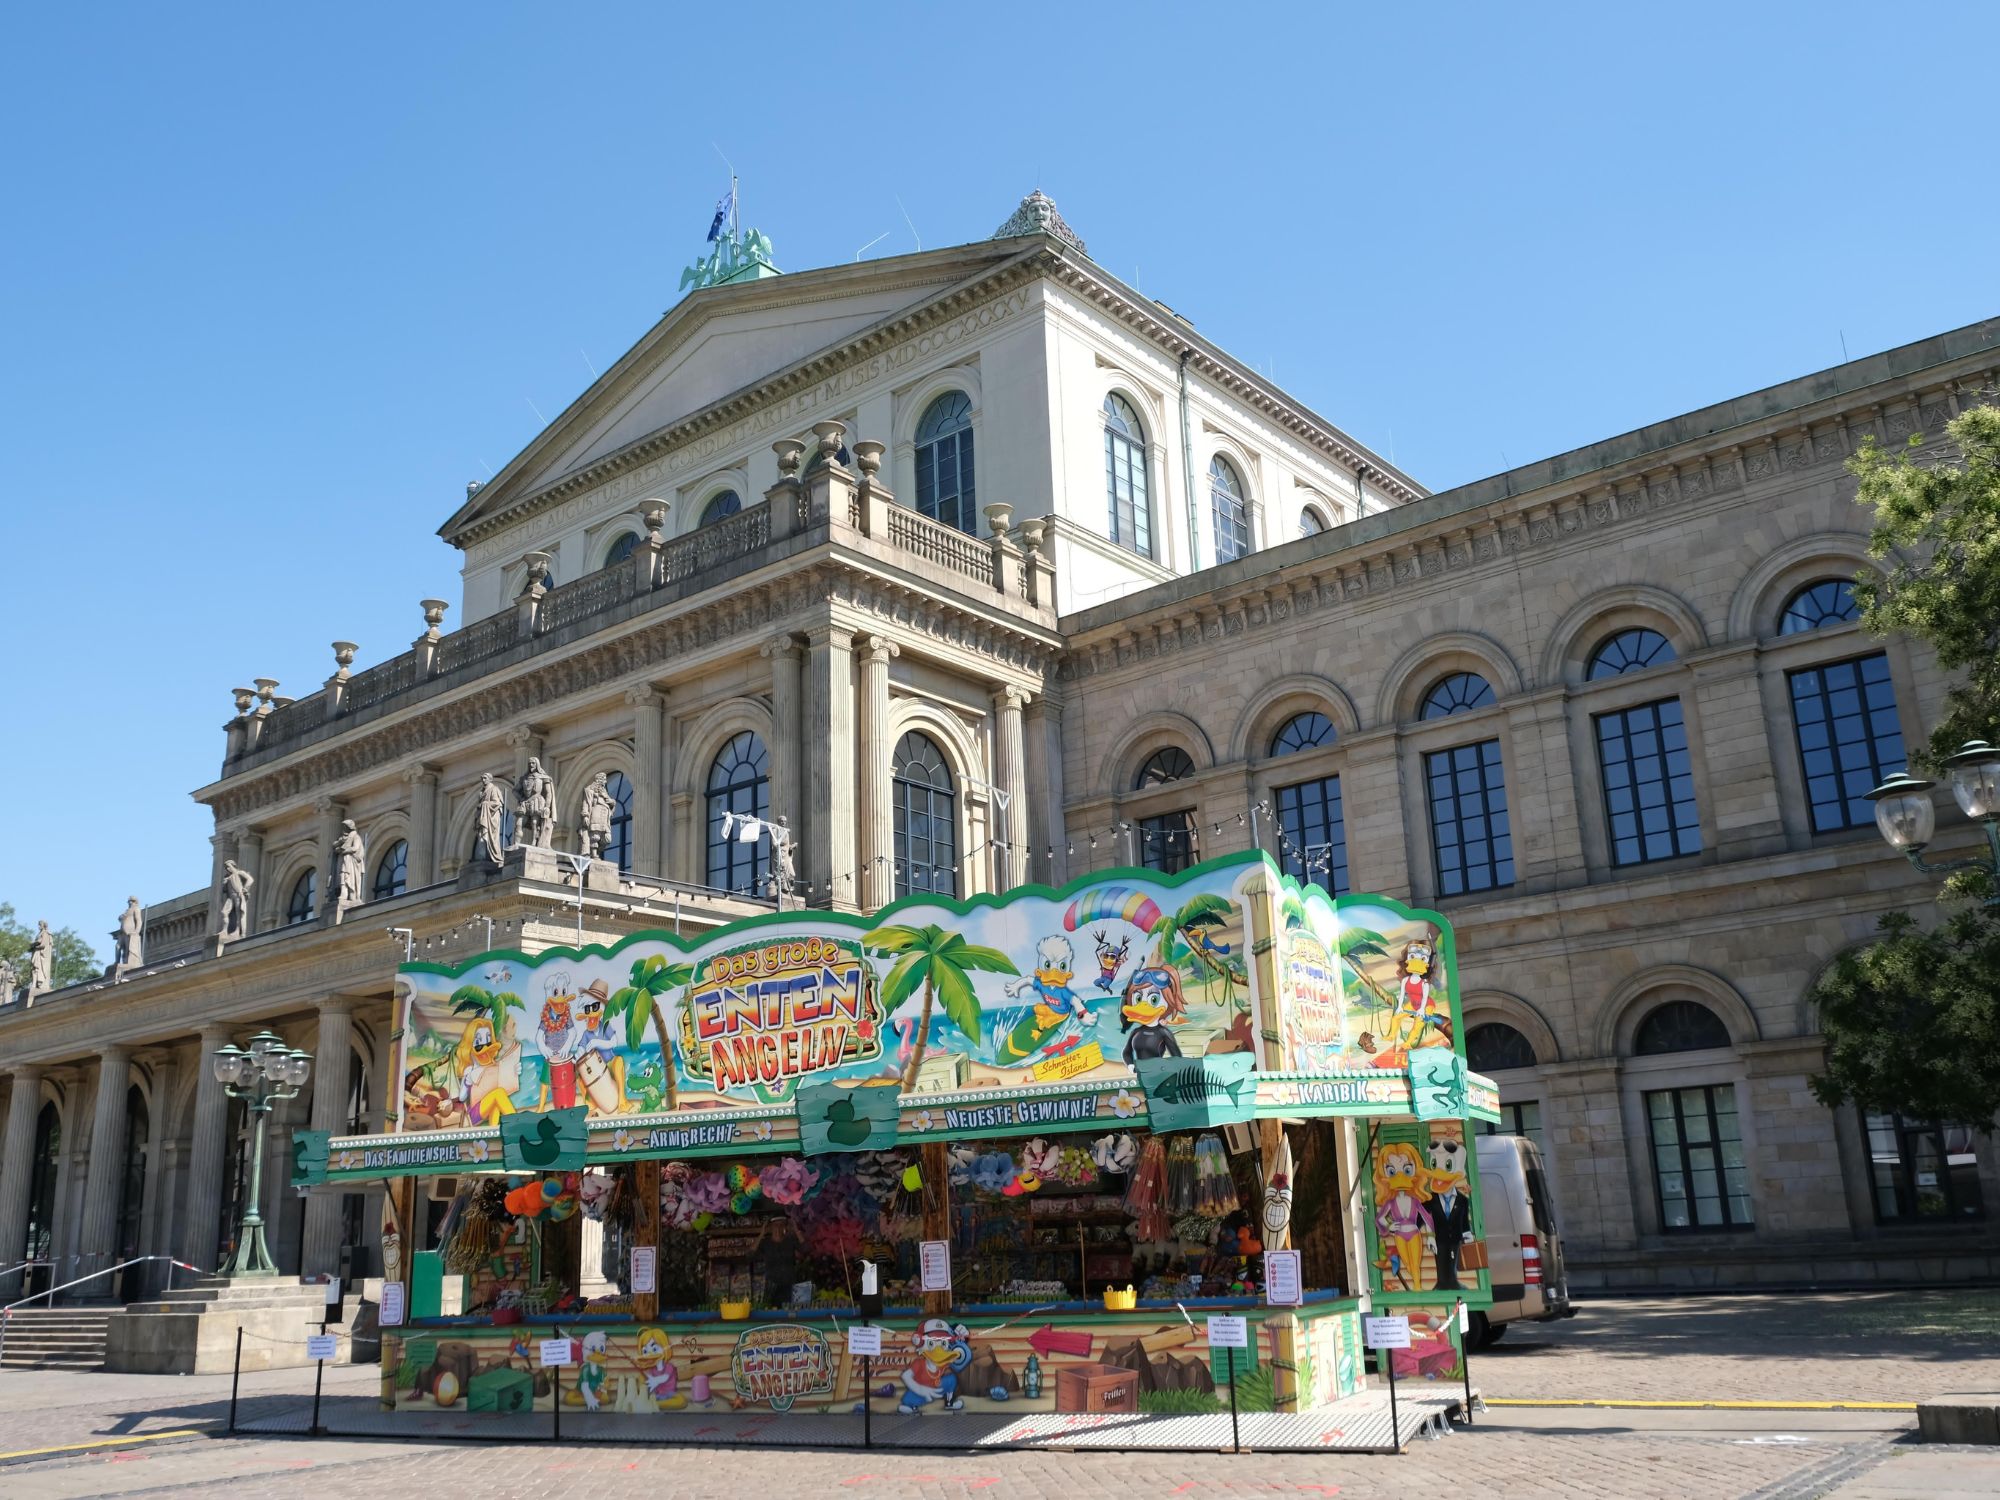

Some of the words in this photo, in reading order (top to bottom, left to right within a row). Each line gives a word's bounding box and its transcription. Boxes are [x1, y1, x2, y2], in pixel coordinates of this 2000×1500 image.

[796, 388, 821, 414] ET
[825, 360, 880, 400] MUSIS
[713, 953, 758, 982] Das
[765, 938, 838, 972] große
[695, 968, 861, 1039] ENTEN
[711, 1026, 846, 1092] ANGELN
[1041, 1053, 1081, 1075] Schnatter
[1060, 1057, 1089, 1078] Island
[1298, 1080, 1368, 1104] KARIBIK
[945, 1105, 1012, 1129] NEUESTE
[1017, 1094, 1099, 1123] GEWINNE!
[364, 1150, 384, 1168] DAS
[386, 1145, 462, 1167] FAMILIENSPIEL
[742, 1344, 821, 1373] ENTEN
[750, 1372, 814, 1398] ANGELN
